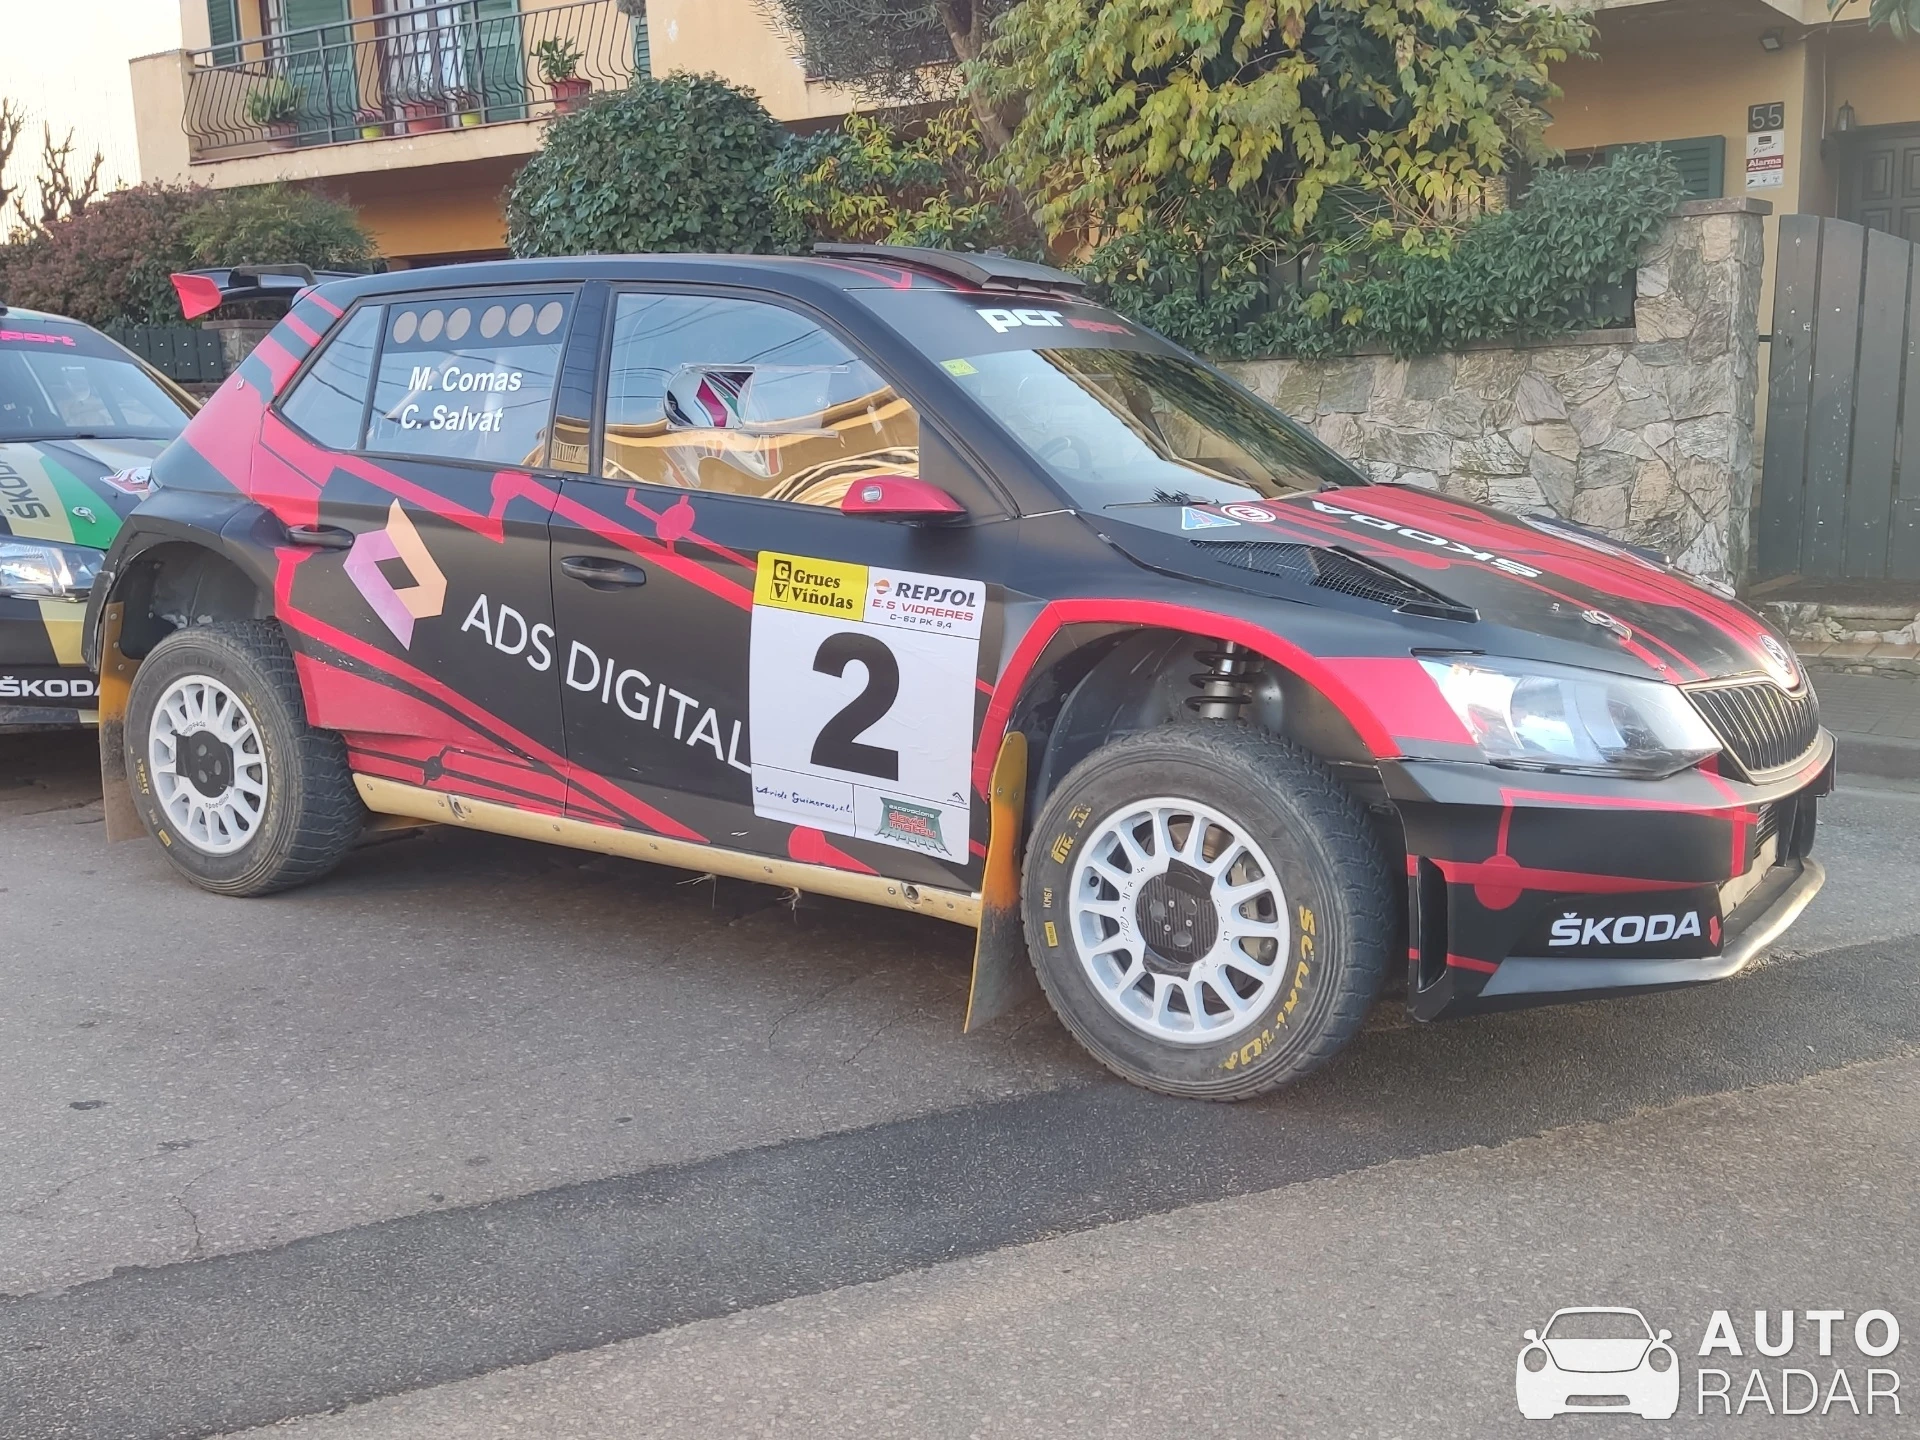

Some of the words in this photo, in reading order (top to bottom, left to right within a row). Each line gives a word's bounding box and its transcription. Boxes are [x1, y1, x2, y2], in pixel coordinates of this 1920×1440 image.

[1752, 103, 1782, 129] 55
[1748, 158, 1782, 168] Alarma
[975, 308, 1064, 333] pcr
[408, 366, 433, 391] M.
[441, 366, 523, 392] Comas
[400, 404, 422, 429] C.
[429, 404, 504, 432] Salvat
[793, 568, 841, 589] Grues
[792, 586, 854, 610] Viñolas
[895, 582, 977, 608] REPSOL
[871, 599, 896, 610] E.S
[901, 603, 974, 622] VIDRERES
[889, 613, 916, 624] C-63
[919, 618, 933, 626] PK
[936, 620, 952, 630] 9,4
[460, 593, 555, 672] ADS
[566, 640, 752, 774] DIGITAL
[810, 632, 900, 781] 2
[888, 810, 927, 828] david
[1548, 911, 1702, 946] ŠKODA
